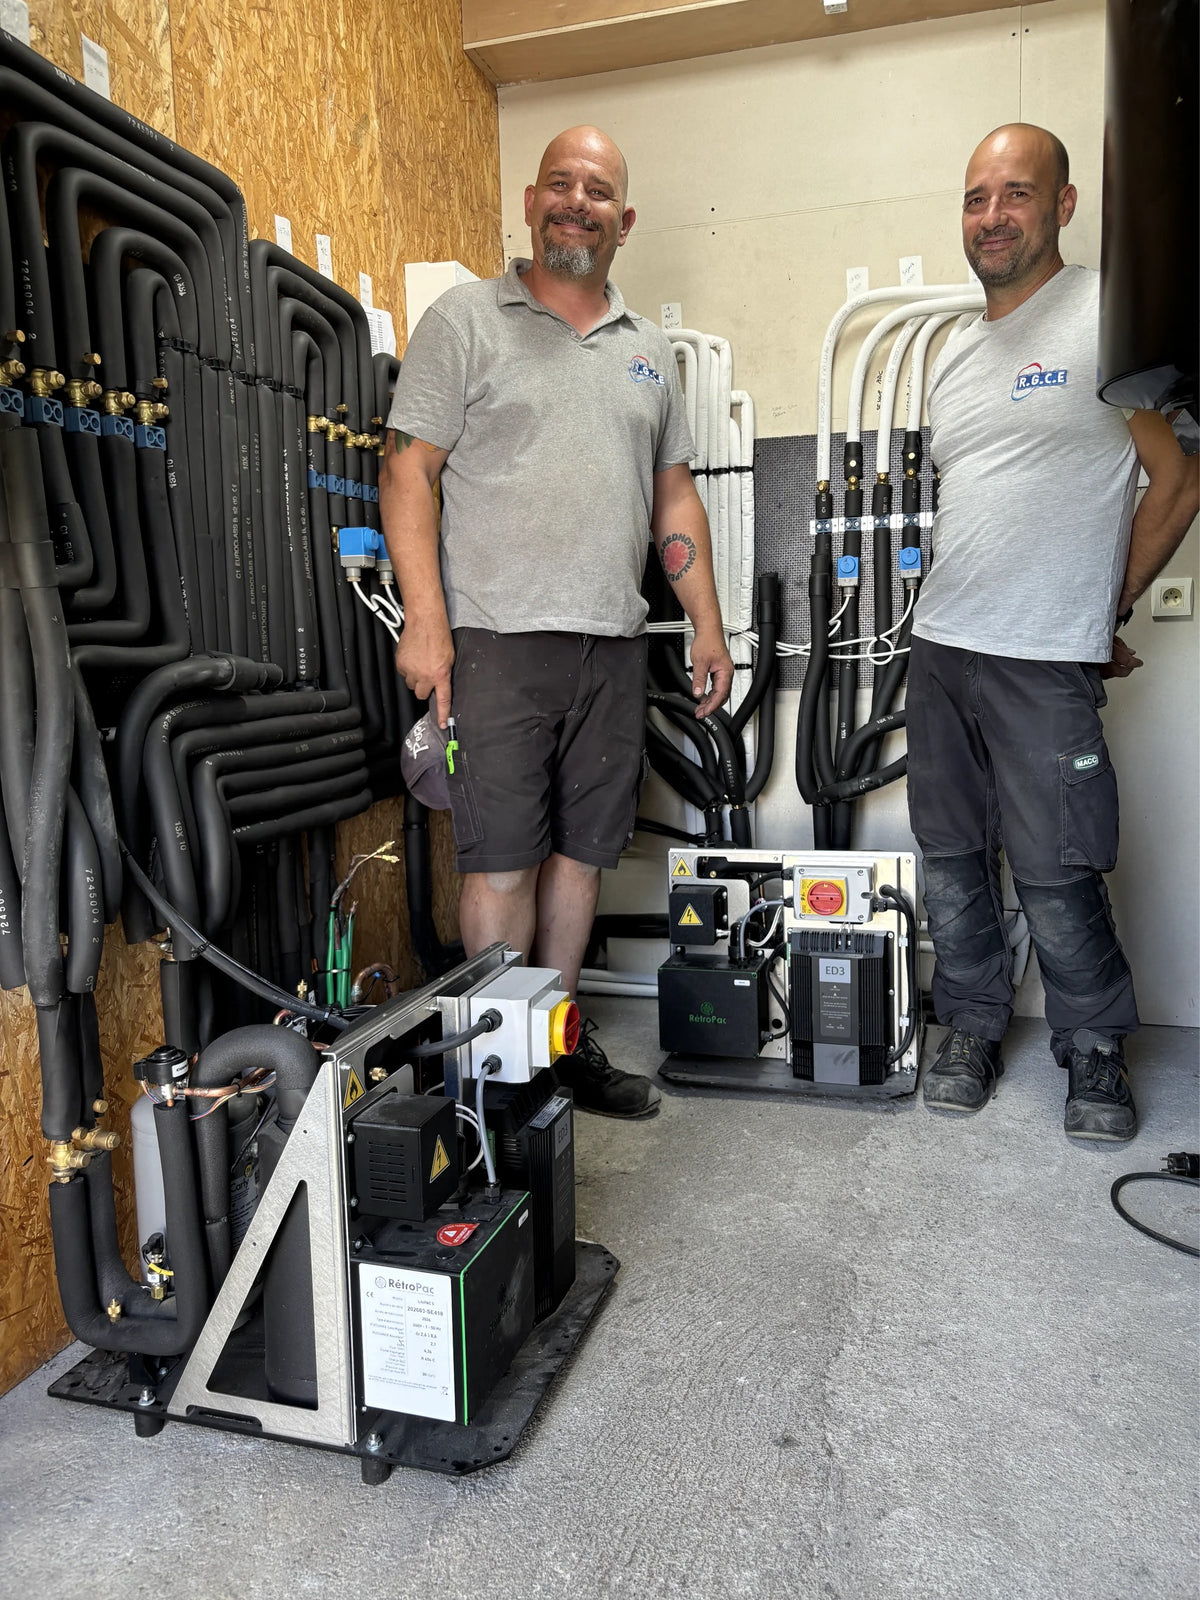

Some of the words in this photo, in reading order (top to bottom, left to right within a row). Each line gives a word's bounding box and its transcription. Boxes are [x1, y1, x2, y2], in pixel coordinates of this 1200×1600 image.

[1018, 372, 1065, 388] R.G.C.E
[1077, 756, 1097, 767] MACC
[174, 820, 184, 838] 13X
[180, 840, 187, 850] 10
[84, 868, 100, 924] 7245004
[826, 966, 845, 976] ED3
[388, 1278, 434, 1294] RétroPac
